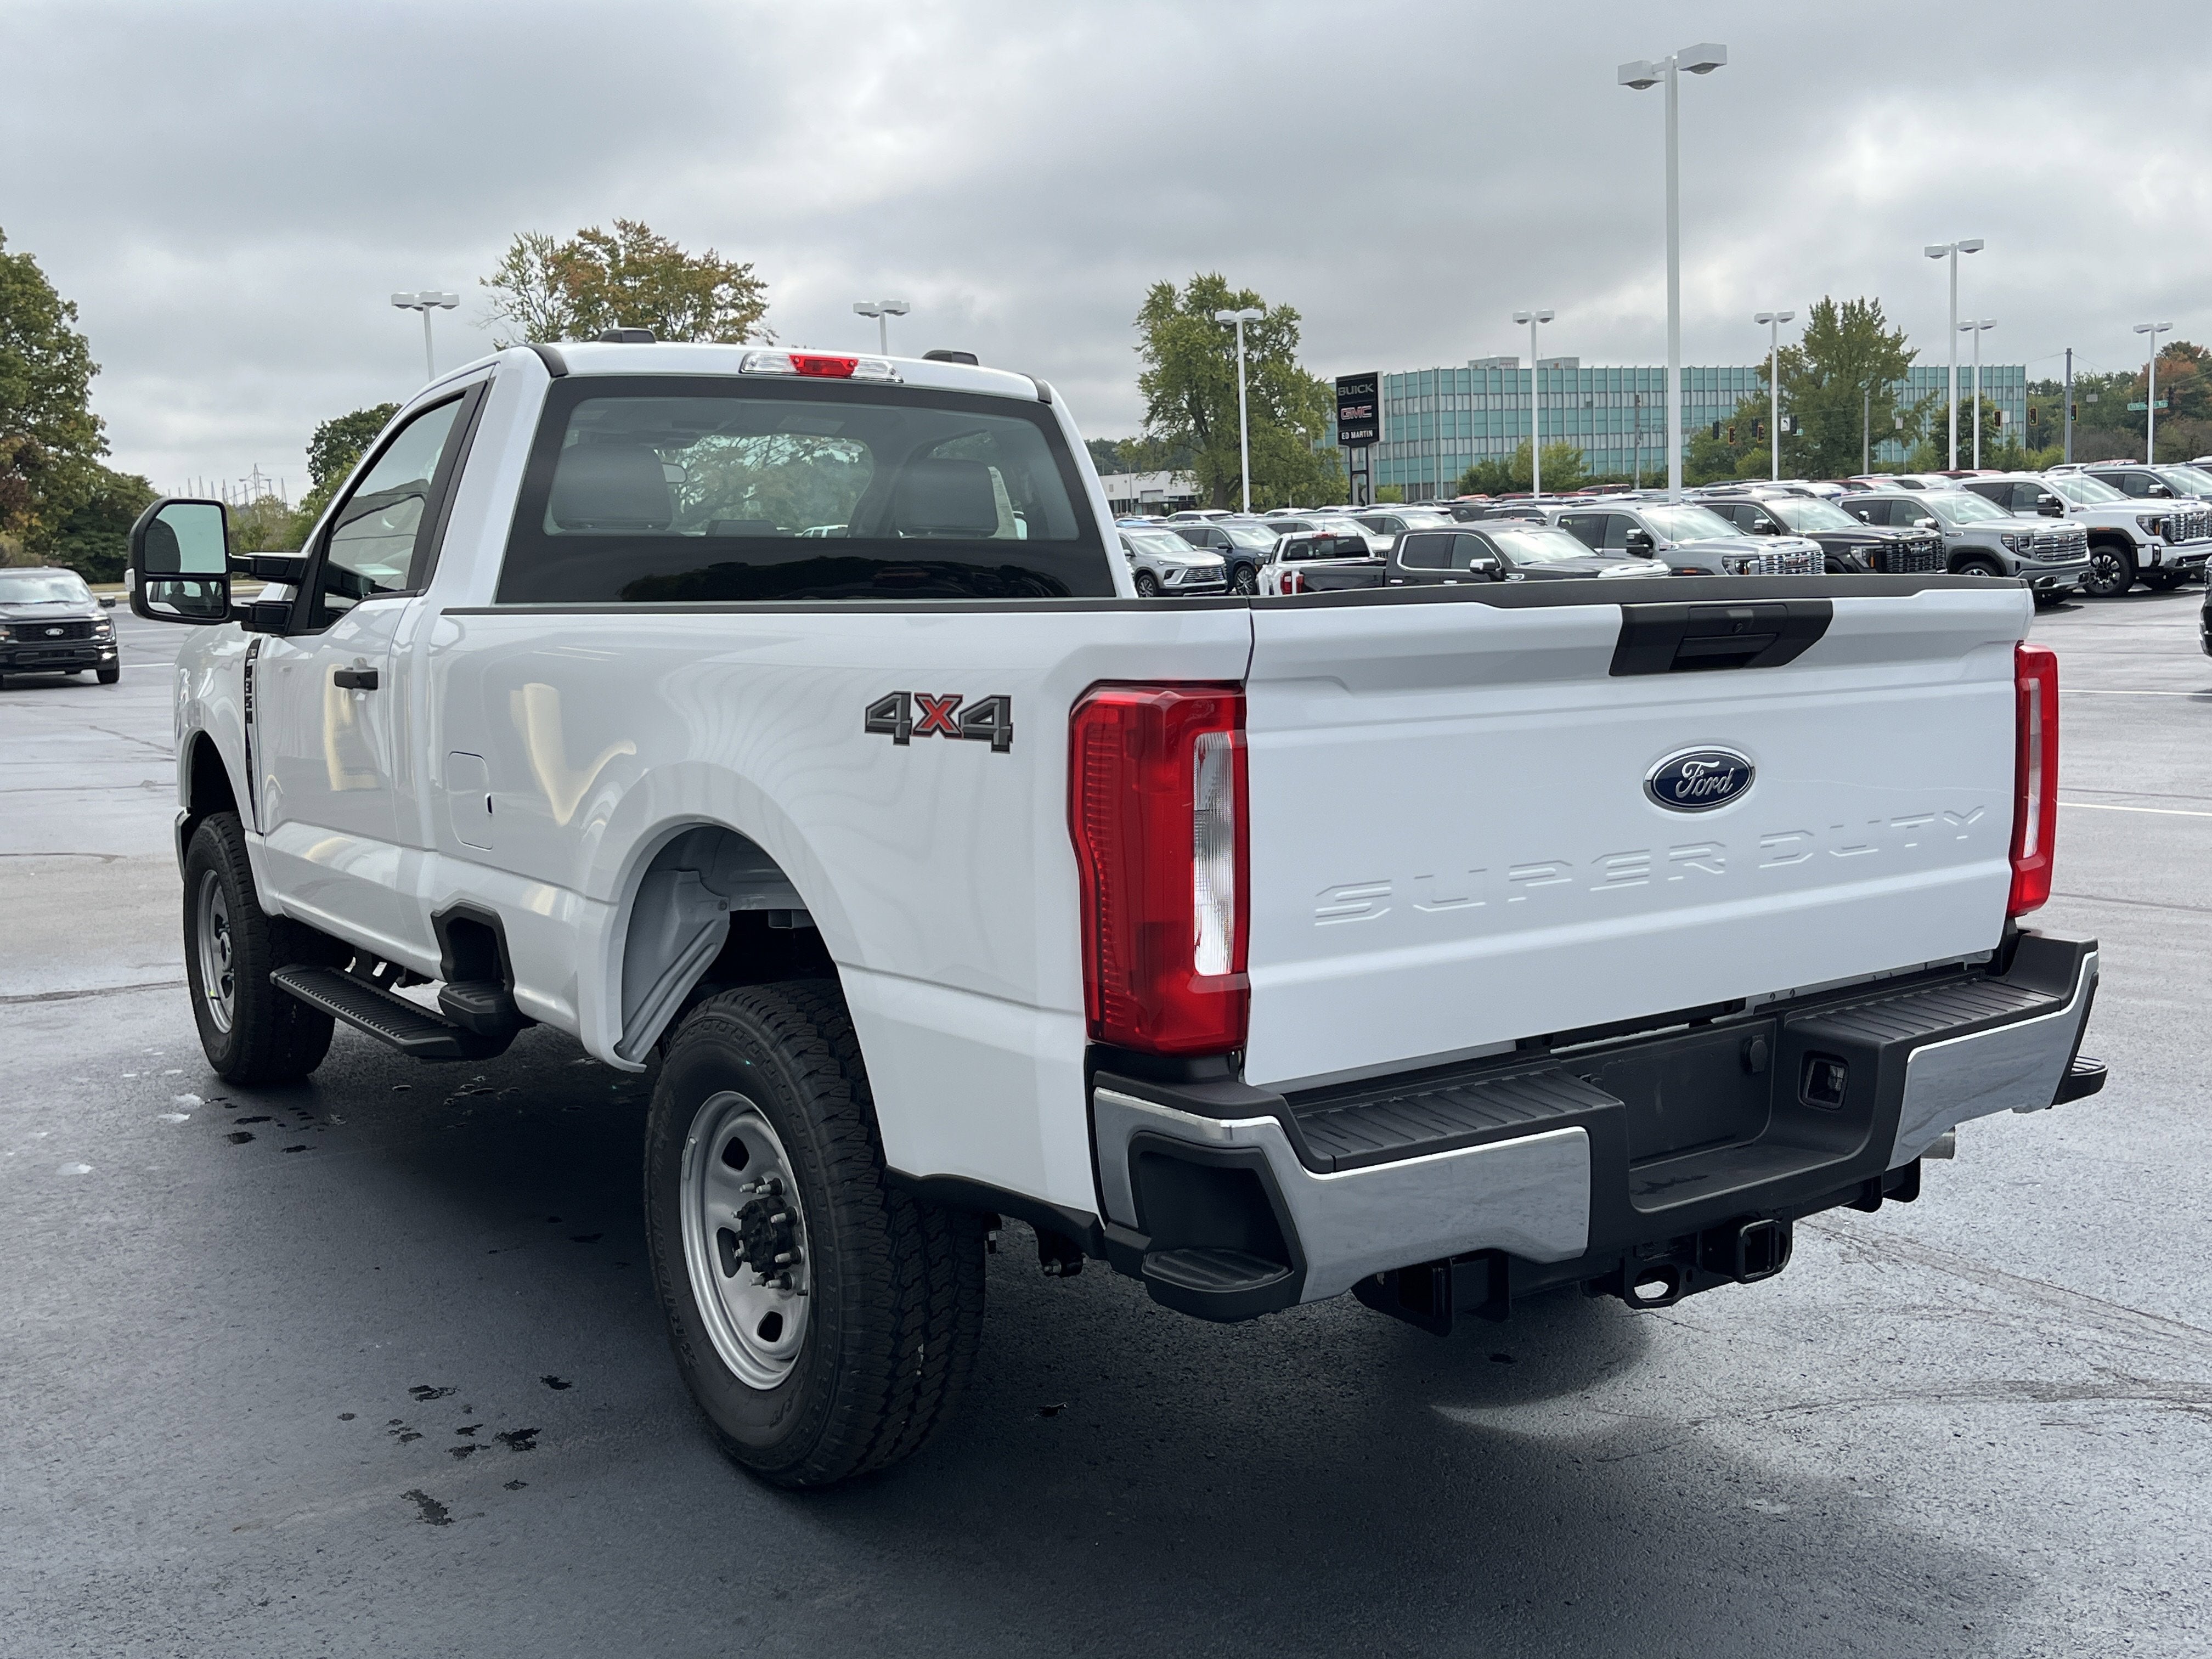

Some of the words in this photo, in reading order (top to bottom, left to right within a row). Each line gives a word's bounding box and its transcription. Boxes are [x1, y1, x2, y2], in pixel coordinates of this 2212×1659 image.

[1338, 383, 1374, 396] BUICK
[1341, 405, 1372, 420] GMC
[1341, 431, 1350, 439] ED
[1351, 430, 1373, 439] MARTIN
[1675, 760, 1734, 798] Ford
[1315, 840, 1725, 926] SUPER
[1759, 805, 1984, 868] DUTY
